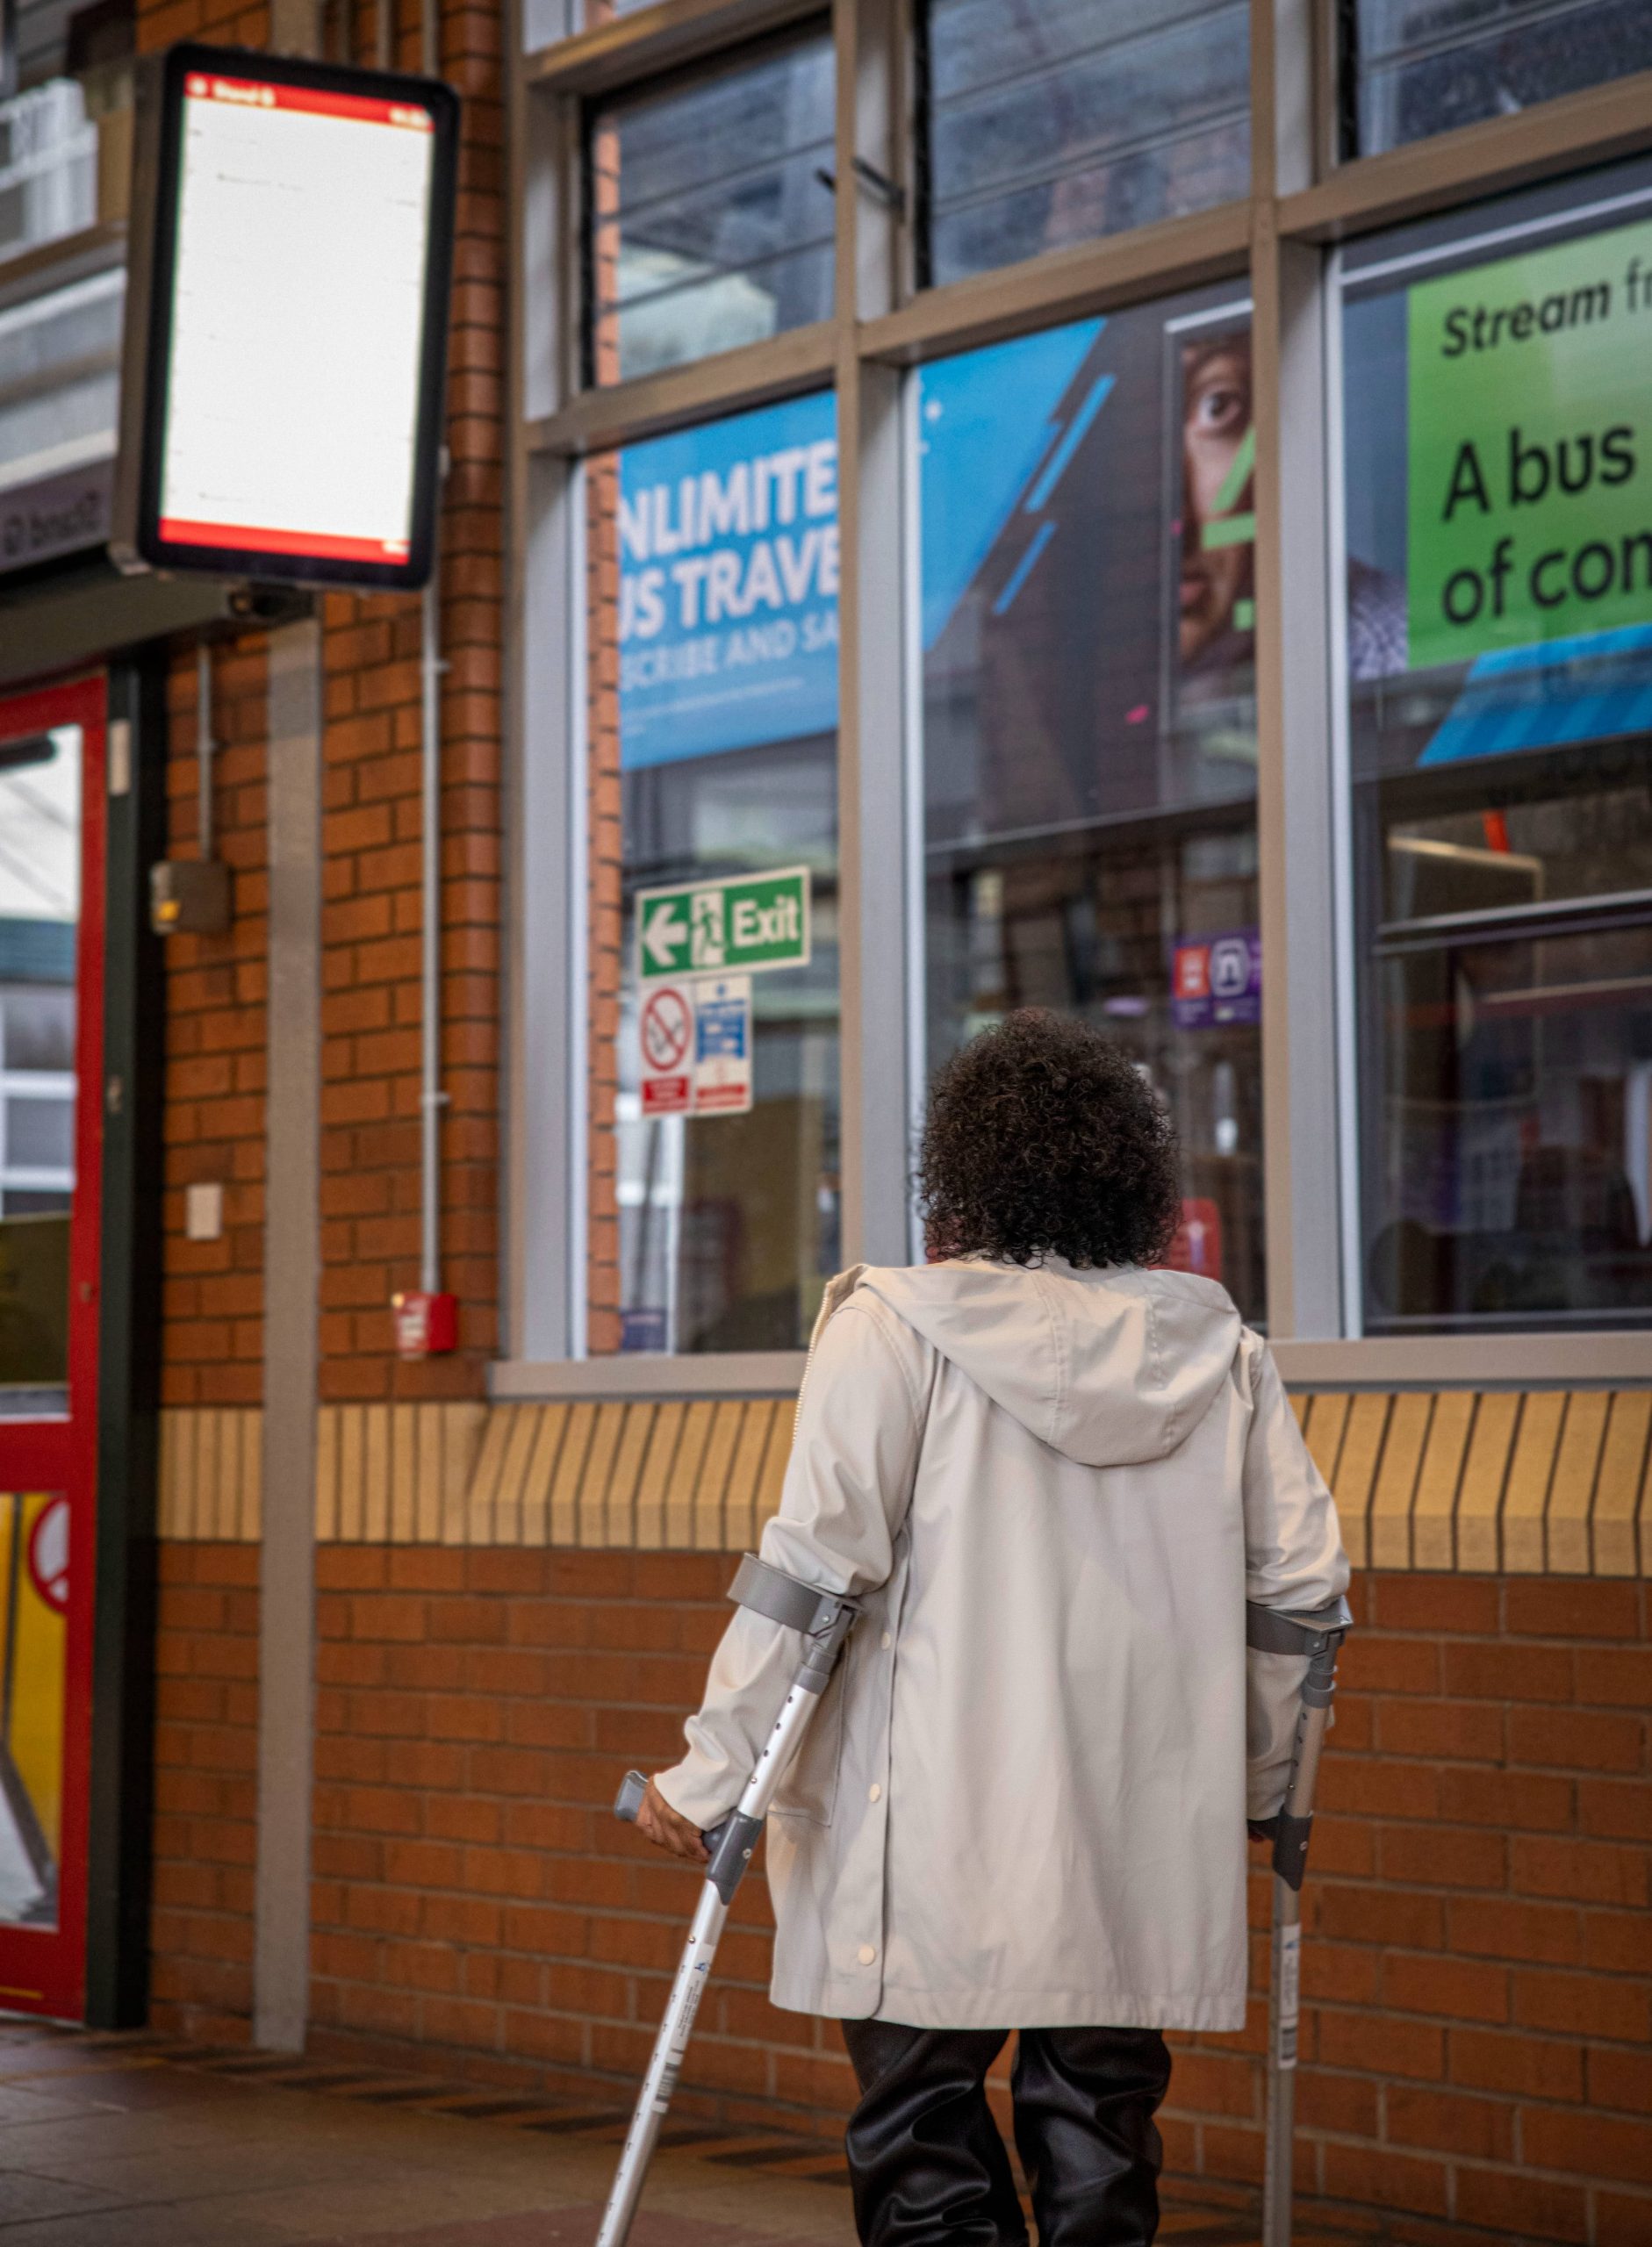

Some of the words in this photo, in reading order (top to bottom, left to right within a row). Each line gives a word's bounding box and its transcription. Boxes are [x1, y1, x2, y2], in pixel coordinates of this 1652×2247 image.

[1442, 281, 1611, 358] Stream
[1442, 441, 1490, 522] A
[1510, 425, 1635, 506] bus
[1442, 535, 1513, 625] of
[725, 619, 795, 668] AND
[734, 894, 798, 947] Exit
